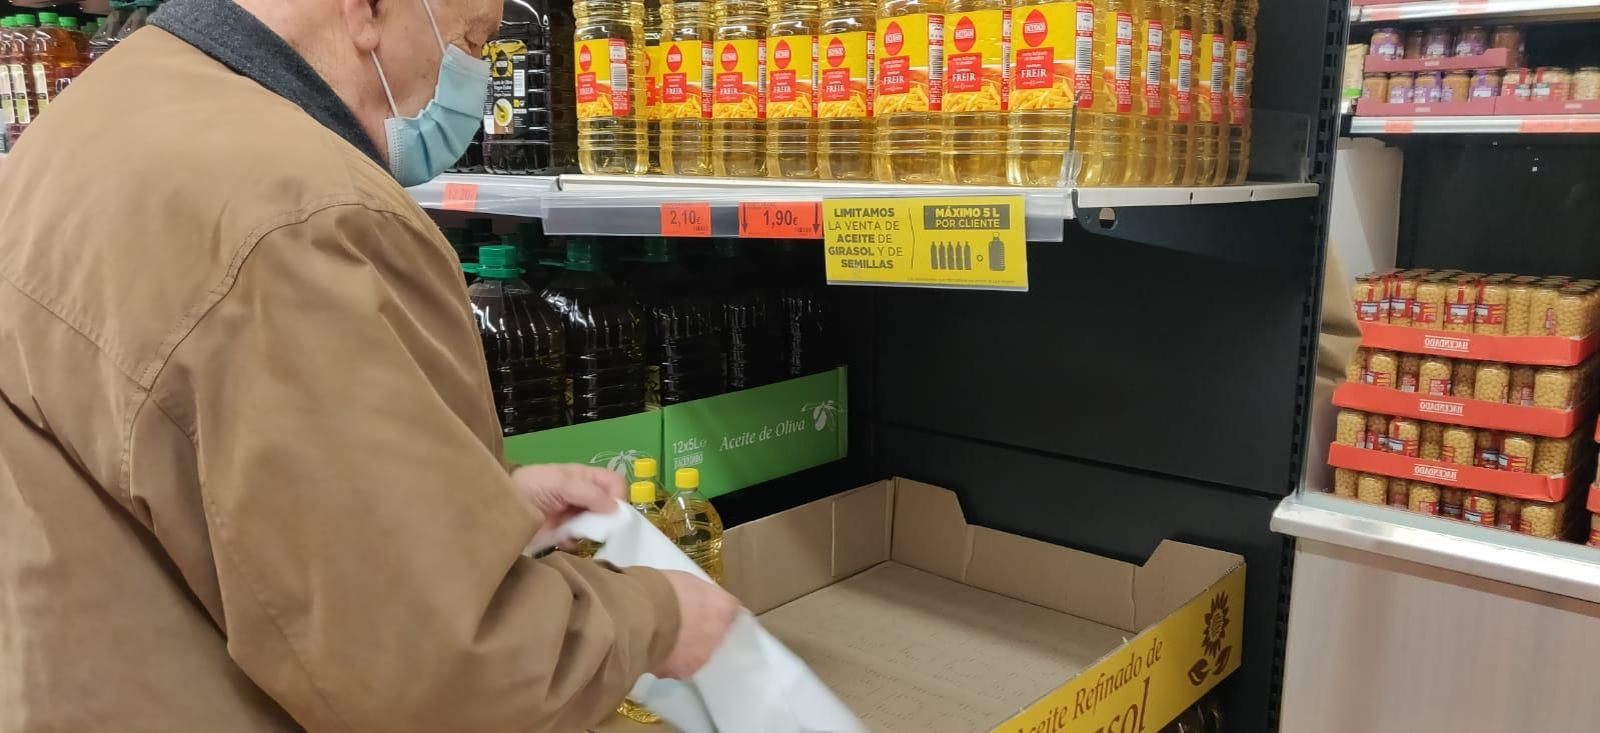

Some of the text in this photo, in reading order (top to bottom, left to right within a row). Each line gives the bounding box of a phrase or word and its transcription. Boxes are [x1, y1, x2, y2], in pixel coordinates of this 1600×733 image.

[952, 73, 976, 82] FREIR
[1021, 69, 1047, 78] FREIR
[834, 207, 895, 218] LIMITAMOS
[935, 206, 1000, 218] MÁXIMO 5 L
[763, 209, 798, 229] 1,90€
[935, 218, 1000, 228] POR CLIENTE
[828, 220, 900, 231] LA VENTA DE
[837, 233, 892, 243] ACEITE DE
[828, 246, 903, 256] GIRASOL Y DE
[841, 258, 894, 269] SEMILLAS
[720, 418, 805, 452] Aceite de Oliva
[1072, 653, 1143, 720] Refinado
[1146, 637, 1163, 668] de
